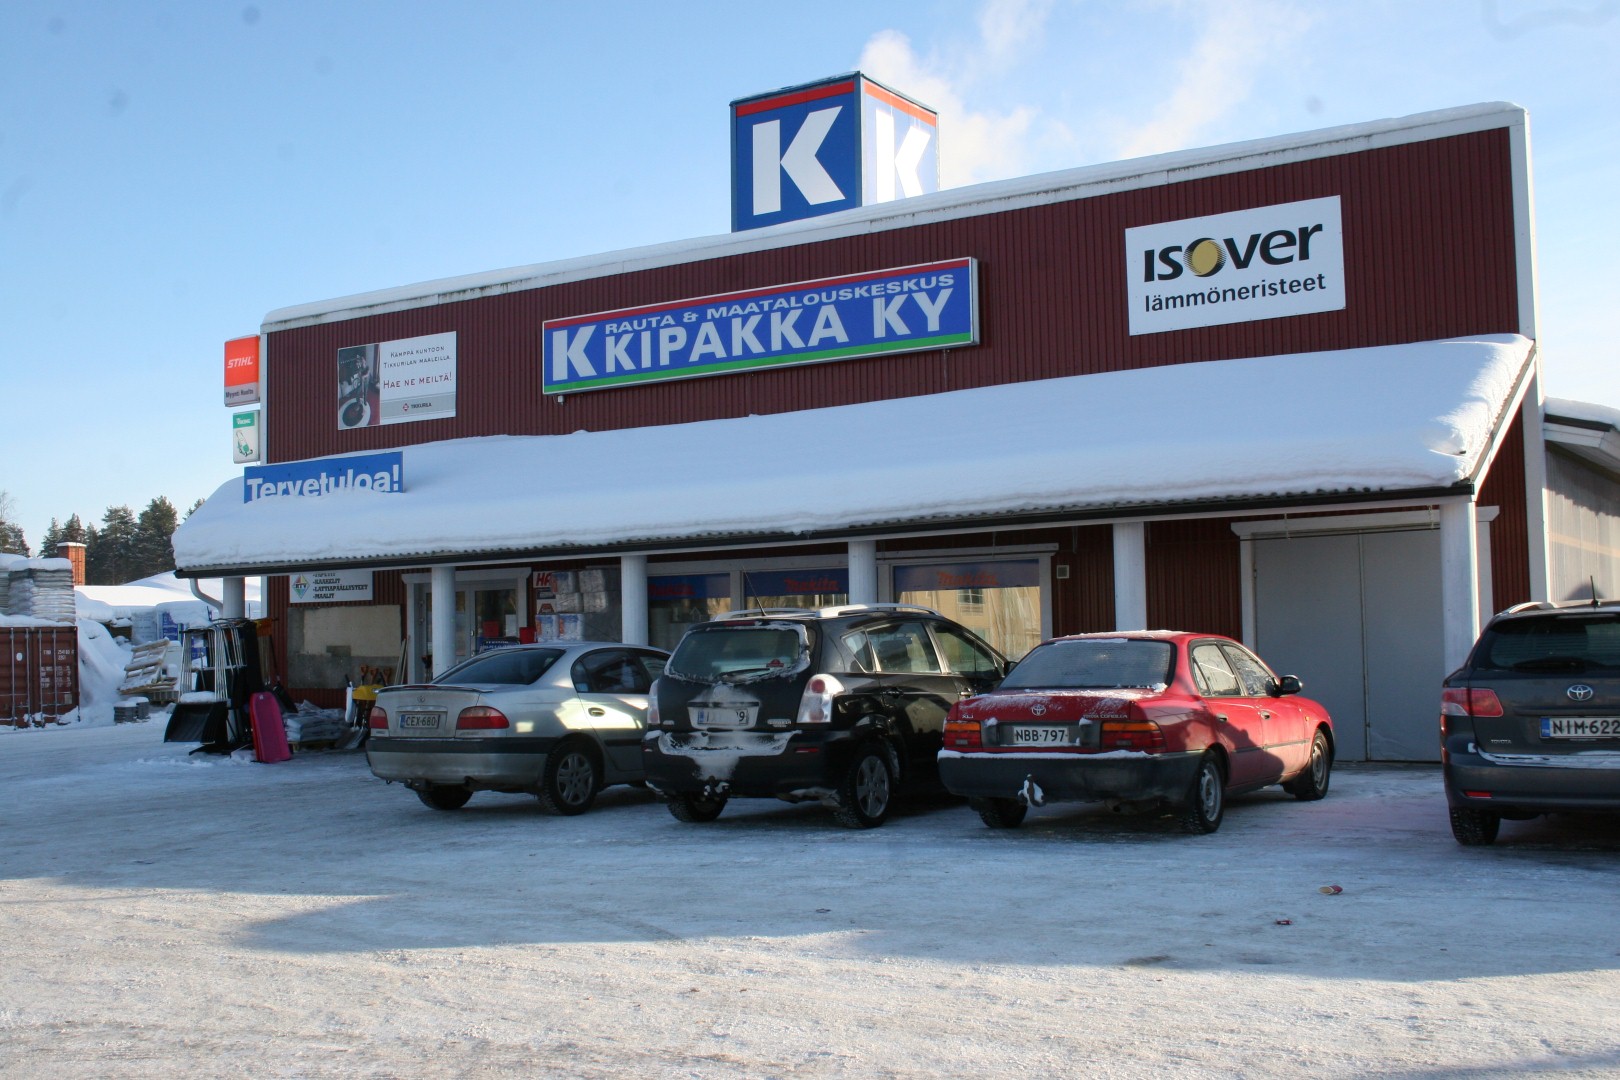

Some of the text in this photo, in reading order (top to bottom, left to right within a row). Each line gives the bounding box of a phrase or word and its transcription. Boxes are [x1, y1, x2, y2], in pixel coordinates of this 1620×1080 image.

[752, 105, 846, 216] K
[875, 108, 931, 204] K
[605, 273, 955, 335] RAUTA & MAATALOUSKESKUS
[1145, 273, 1327, 313] lämmöneristeet
[416, 346, 445, 354] KUNTOON
[605, 287, 954, 374] KIPAKKA KY
[227, 356, 254, 369] STIHL
[383, 360, 417, 369] TIKKURILAN
[552, 325, 597, 381] K
[383, 380, 401, 389] HAE
[404, 378, 416, 387] NE
[246, 464, 399, 501] Tervetuloa!
